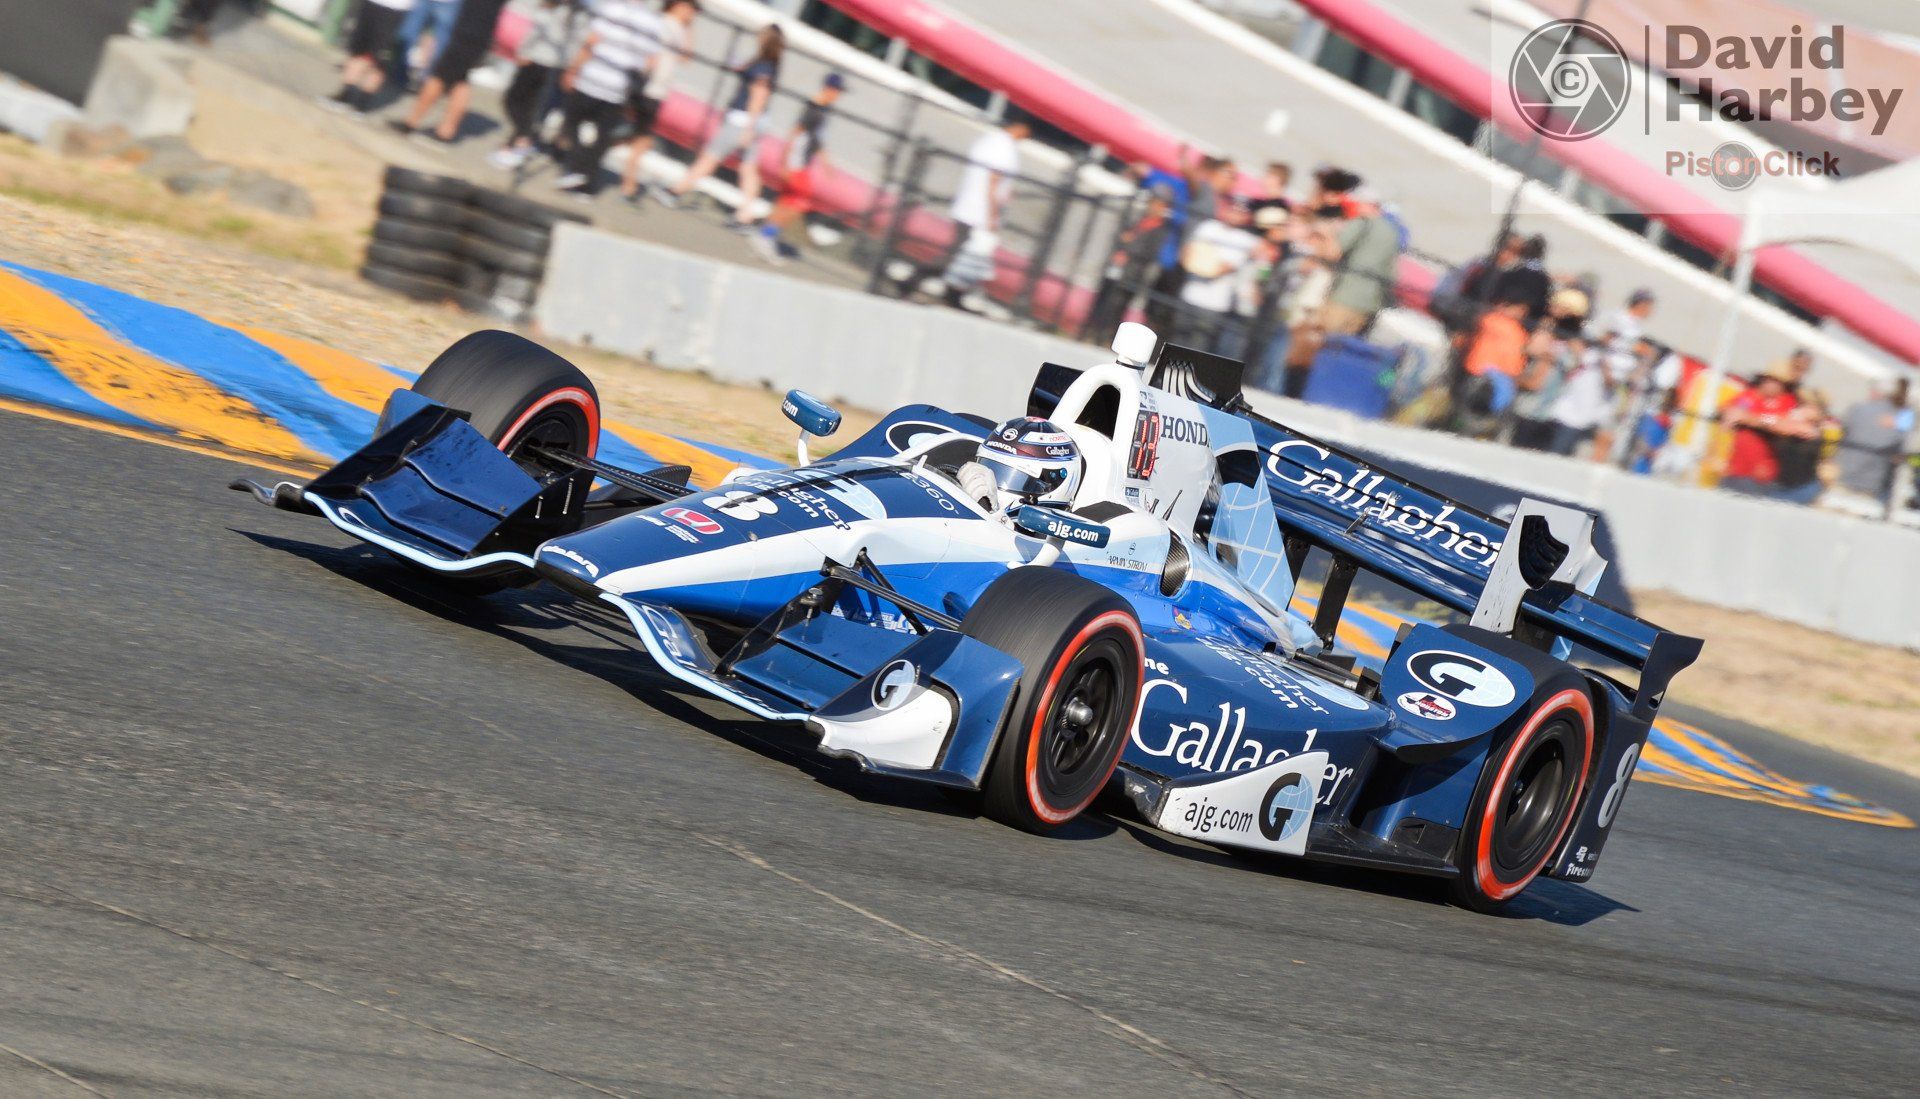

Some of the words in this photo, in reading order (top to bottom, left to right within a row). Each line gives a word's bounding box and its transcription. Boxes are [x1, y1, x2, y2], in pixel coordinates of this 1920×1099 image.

[986, 441, 1017, 455] HONDA
[1161, 415, 1210, 448] HOND
[703, 490, 778, 521] 8
[1266, 440, 1503, 568] Gallagher
[1047, 521, 1100, 543] ajg.com
[1410, 652, 1487, 697] G
[1598, 743, 1640, 828] 8
[1184, 796, 1253, 834] ajg.com
[1258, 772, 1304, 842] G
